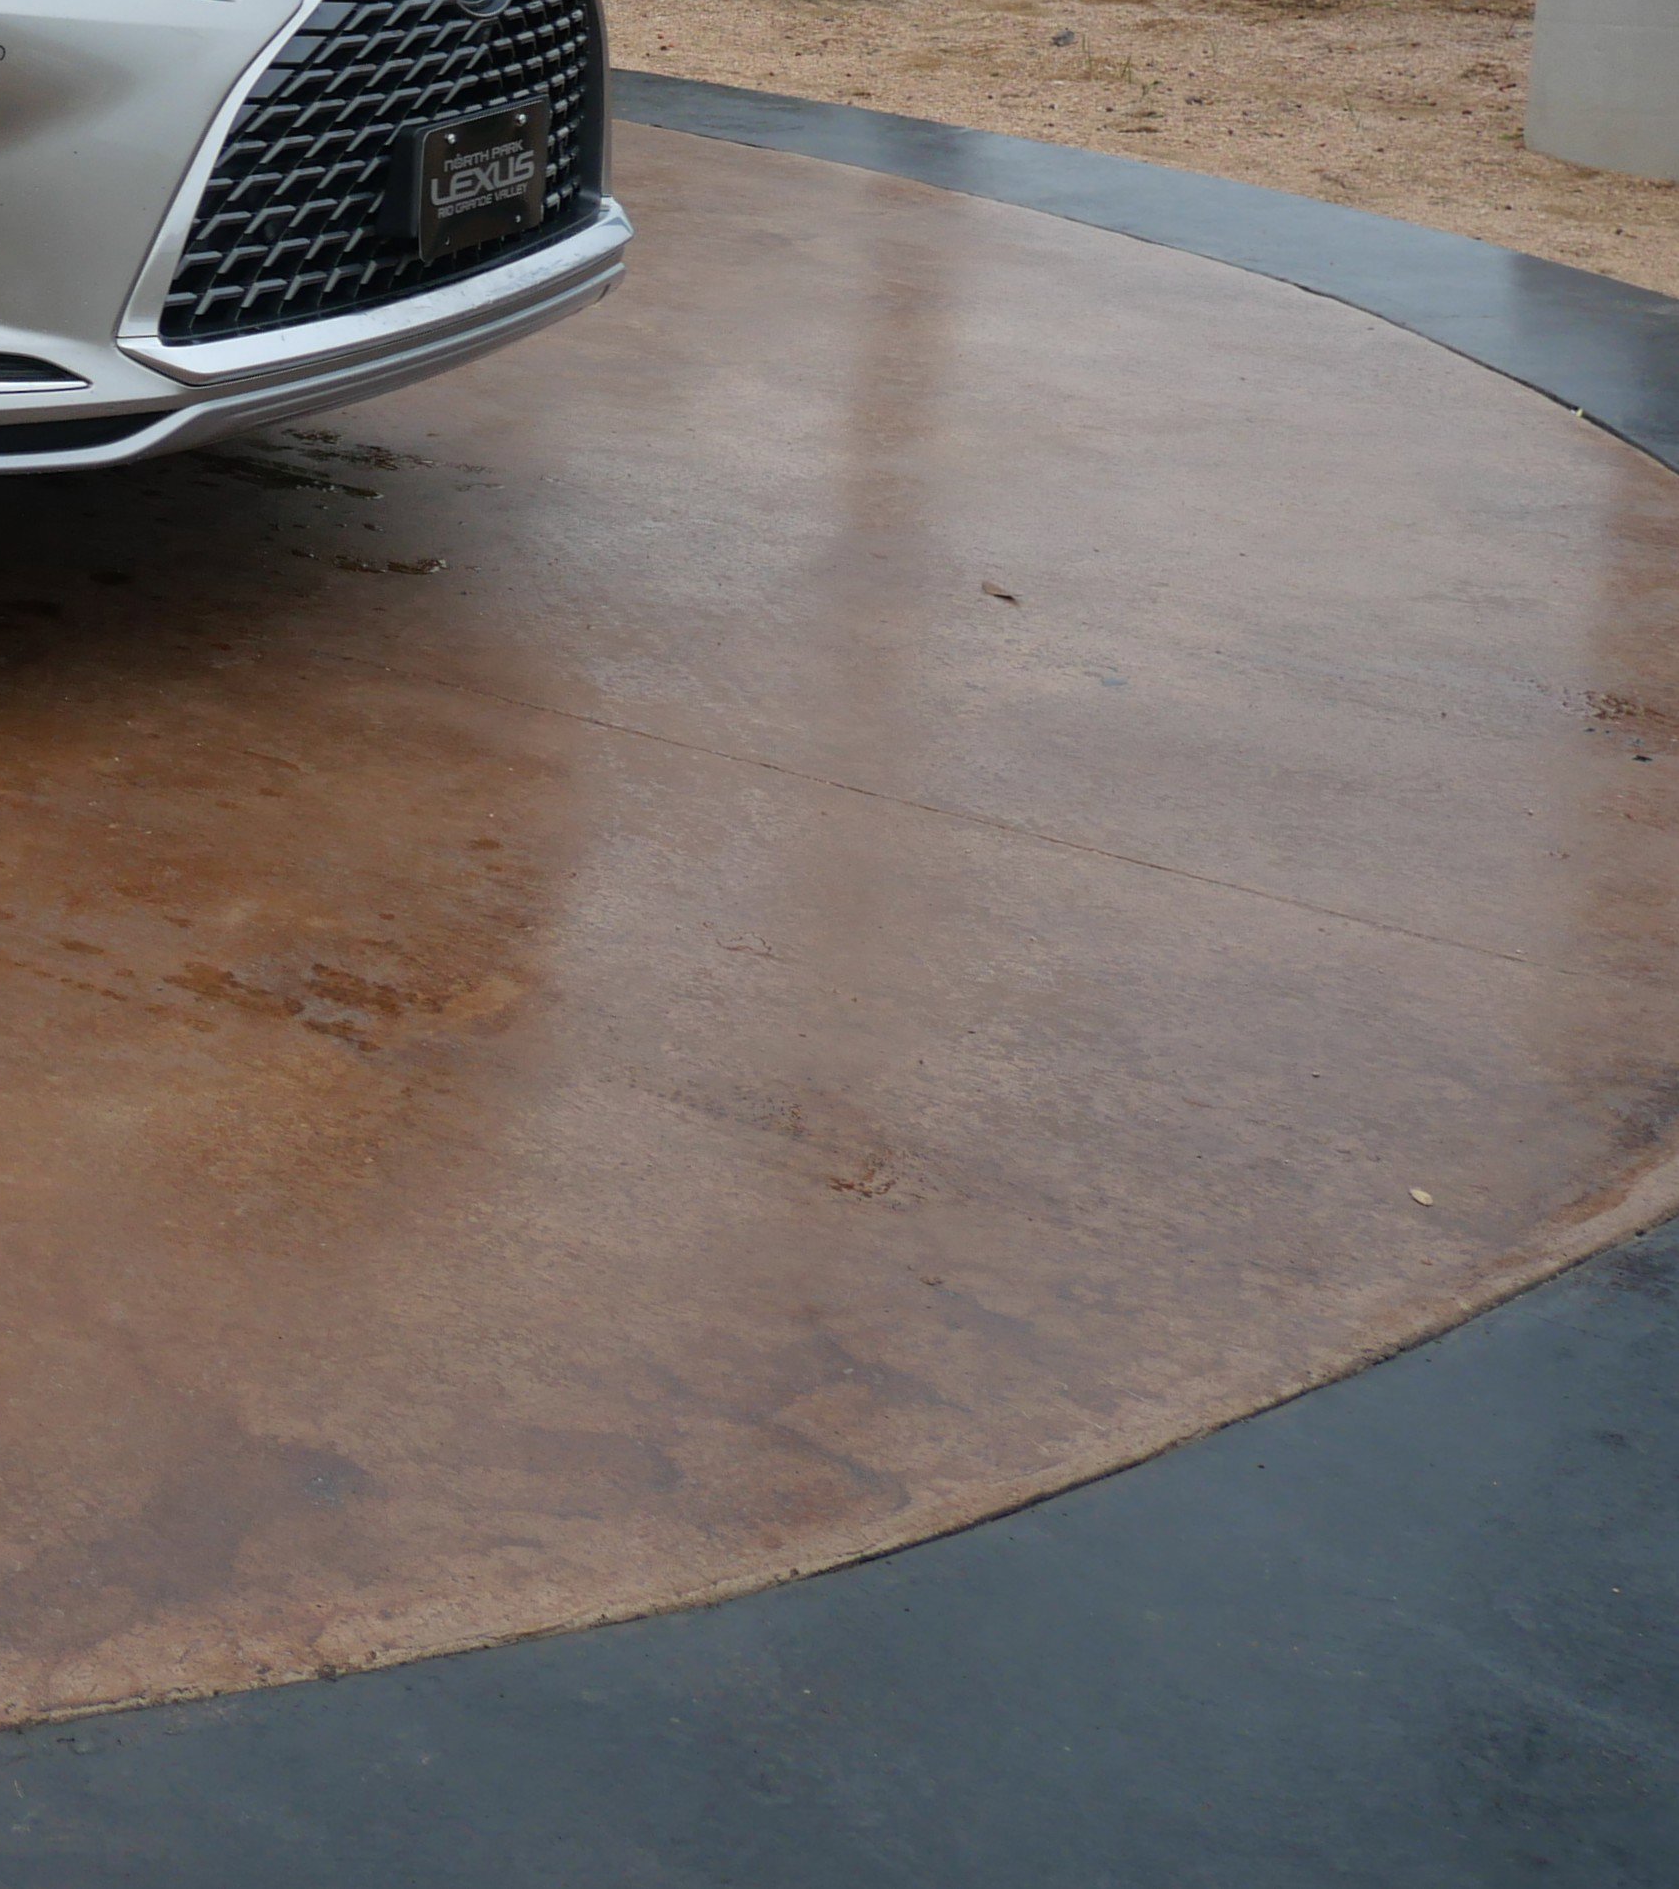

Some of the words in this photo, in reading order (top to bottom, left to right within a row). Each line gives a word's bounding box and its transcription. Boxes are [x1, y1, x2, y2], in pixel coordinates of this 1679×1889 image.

[444, 150, 489, 172] NORTH
[491, 139, 523, 160] PARK
[431, 150, 535, 206] LEXUS
[438, 205, 454, 219] RIO
[455, 193, 493, 215] GRANDE
[494, 183, 528, 201] VALLEY
